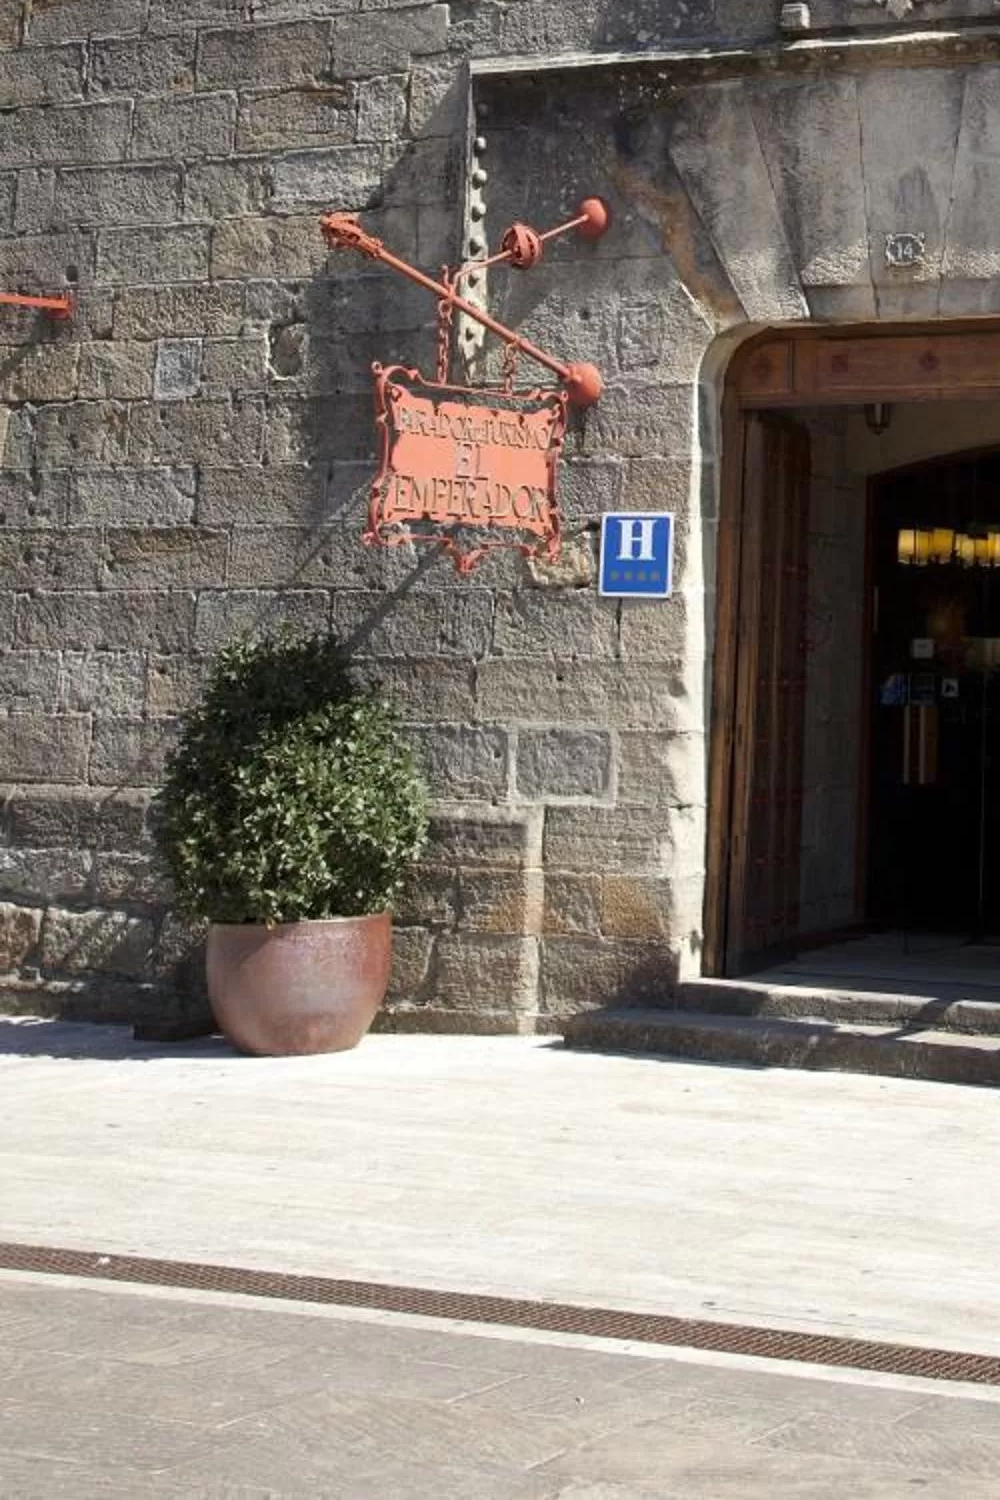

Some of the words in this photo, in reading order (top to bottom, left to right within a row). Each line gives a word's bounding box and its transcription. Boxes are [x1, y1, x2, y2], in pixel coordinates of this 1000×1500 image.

[896, 241, 914, 260] 14
[455, 442, 489, 481] EL
[392, 474, 548, 522] EMPERADOR
[617, 519, 657, 560] H
